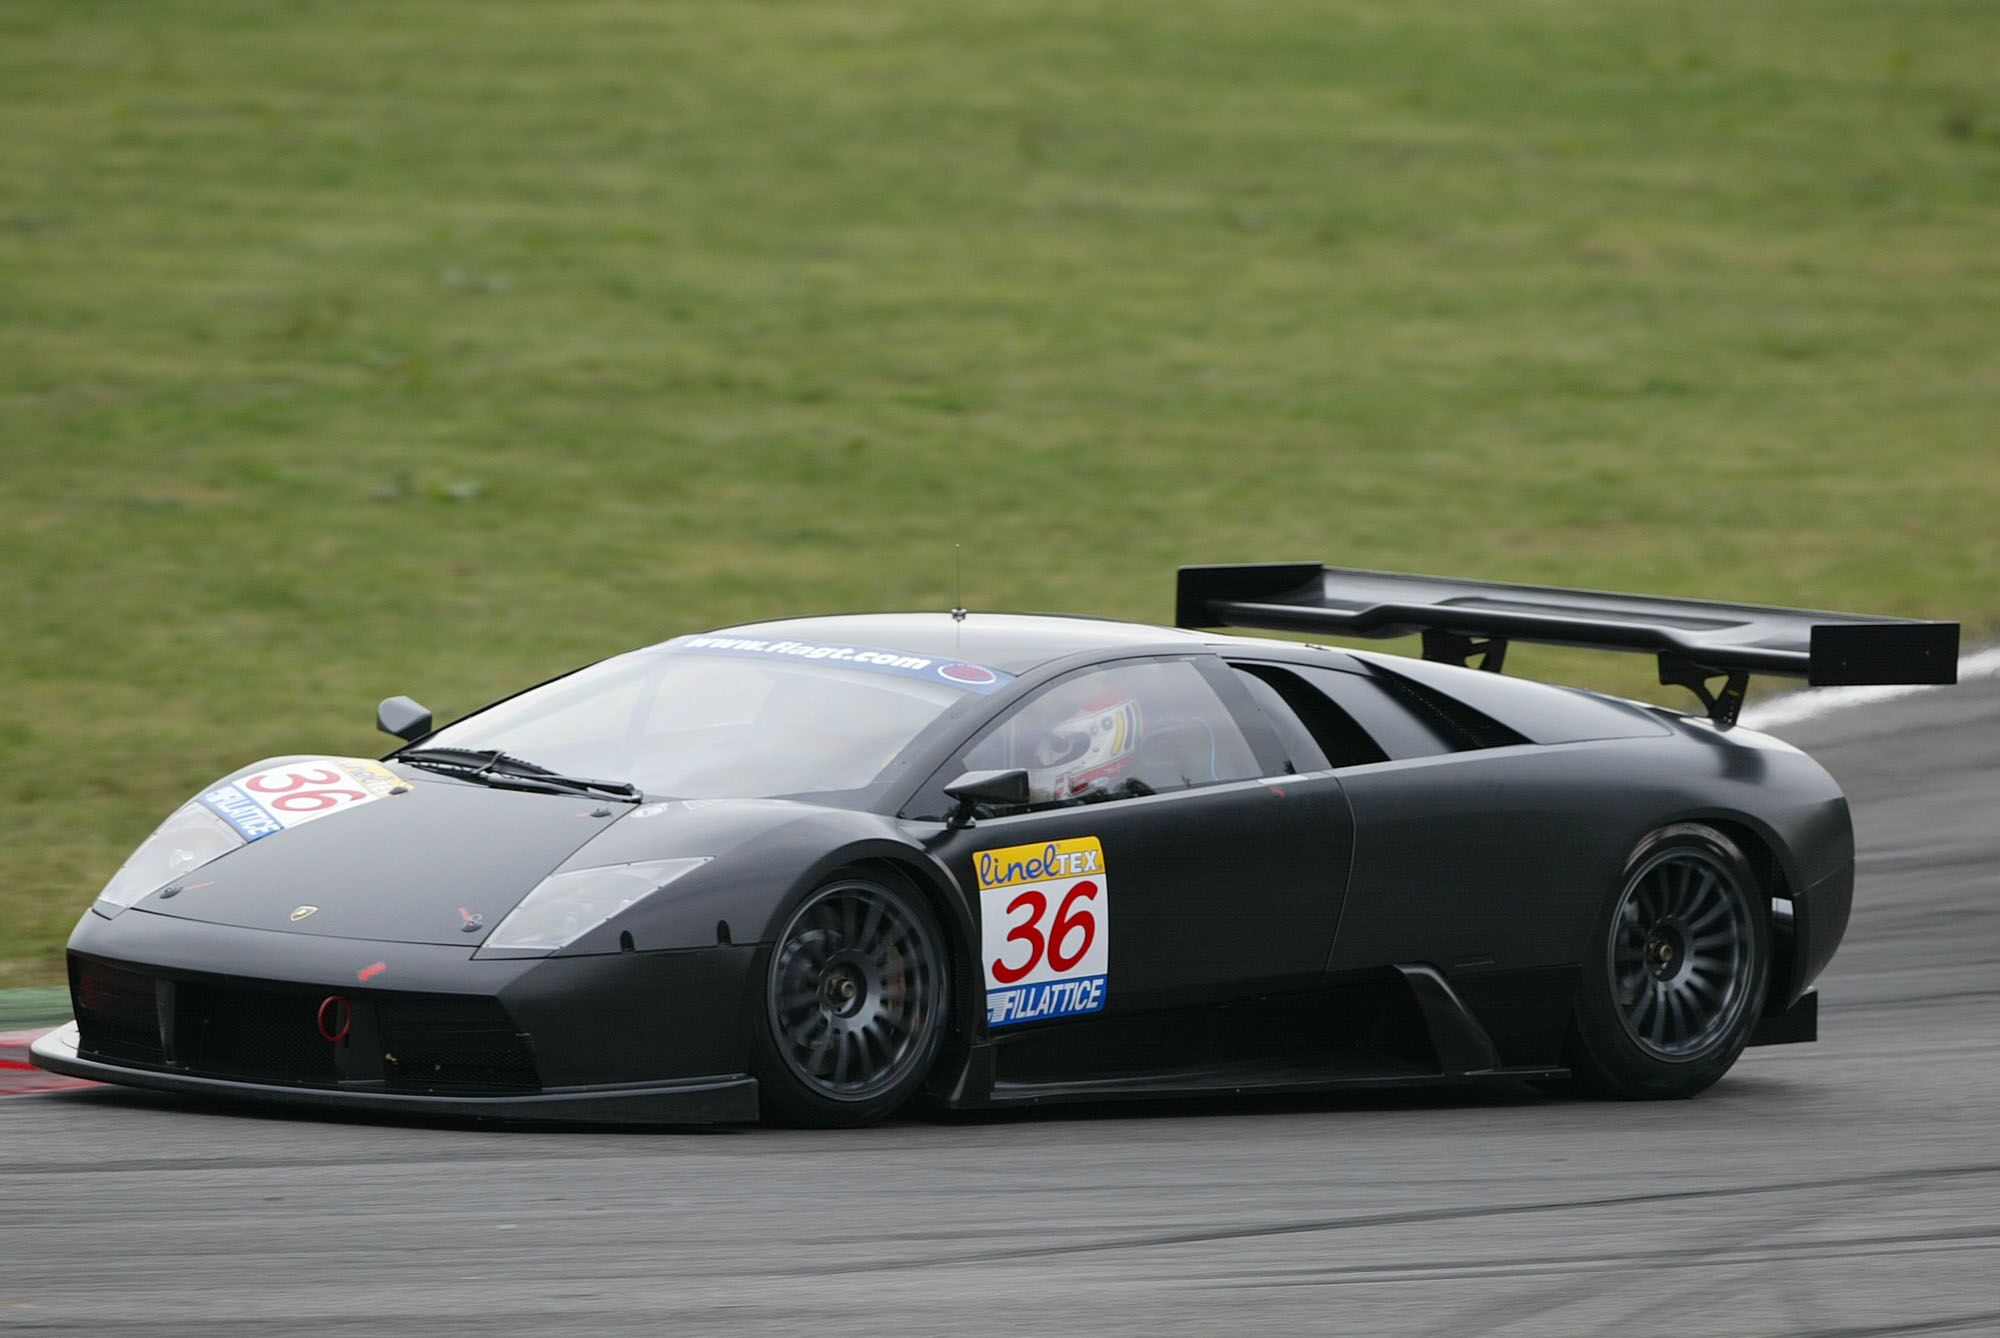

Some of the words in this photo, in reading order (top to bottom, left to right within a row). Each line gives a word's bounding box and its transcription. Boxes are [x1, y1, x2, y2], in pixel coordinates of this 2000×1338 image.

[245, 769, 367, 812] 36
[980, 843, 1098, 886] linelTEX
[992, 880, 1098, 983] 36
[991, 978, 1104, 1023] FILLATTICE
